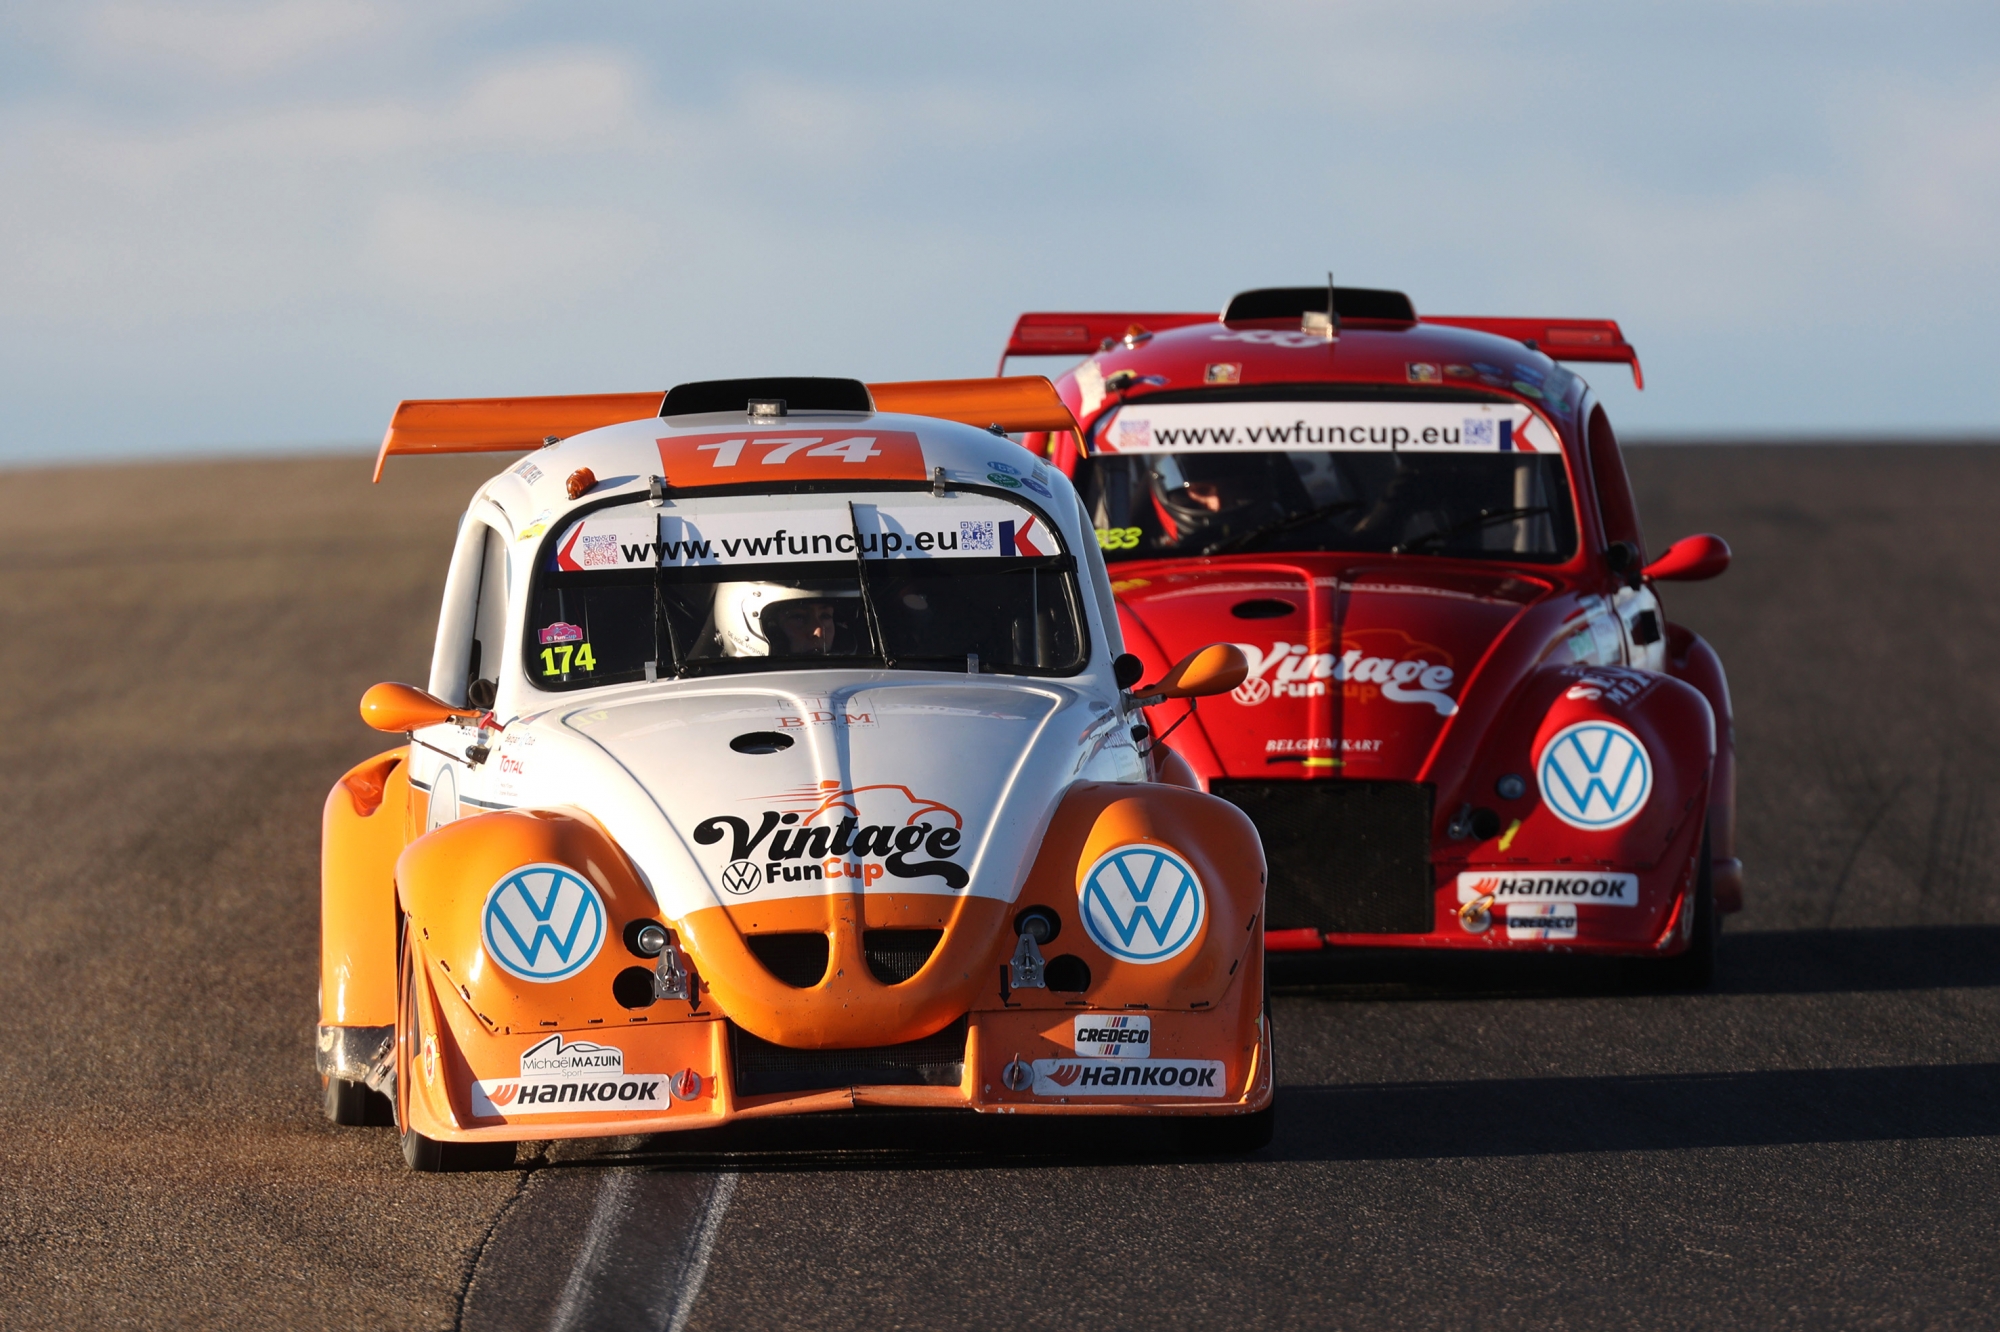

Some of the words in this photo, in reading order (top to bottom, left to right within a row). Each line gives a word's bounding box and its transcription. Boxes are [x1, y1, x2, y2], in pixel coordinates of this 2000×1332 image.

[1154, 420, 1460, 450] www.vwfuncup.eu
[697, 437, 882, 467] 174
[620, 530, 958, 563] www.vwfuncup.eu
[540, 643, 596, 676] 174
[1272, 679, 1379, 705] FunCup
[1265, 737, 1338, 752] BELGIUM
[1341, 738, 1383, 752] KART
[500, 755, 523, 774] TOTAL
[693, 811, 970, 889] Vintage
[766, 857, 884, 887] FunCup
[1077, 1028, 1150, 1043] CREDECO
[562, 1068, 583, 1079] Sport
